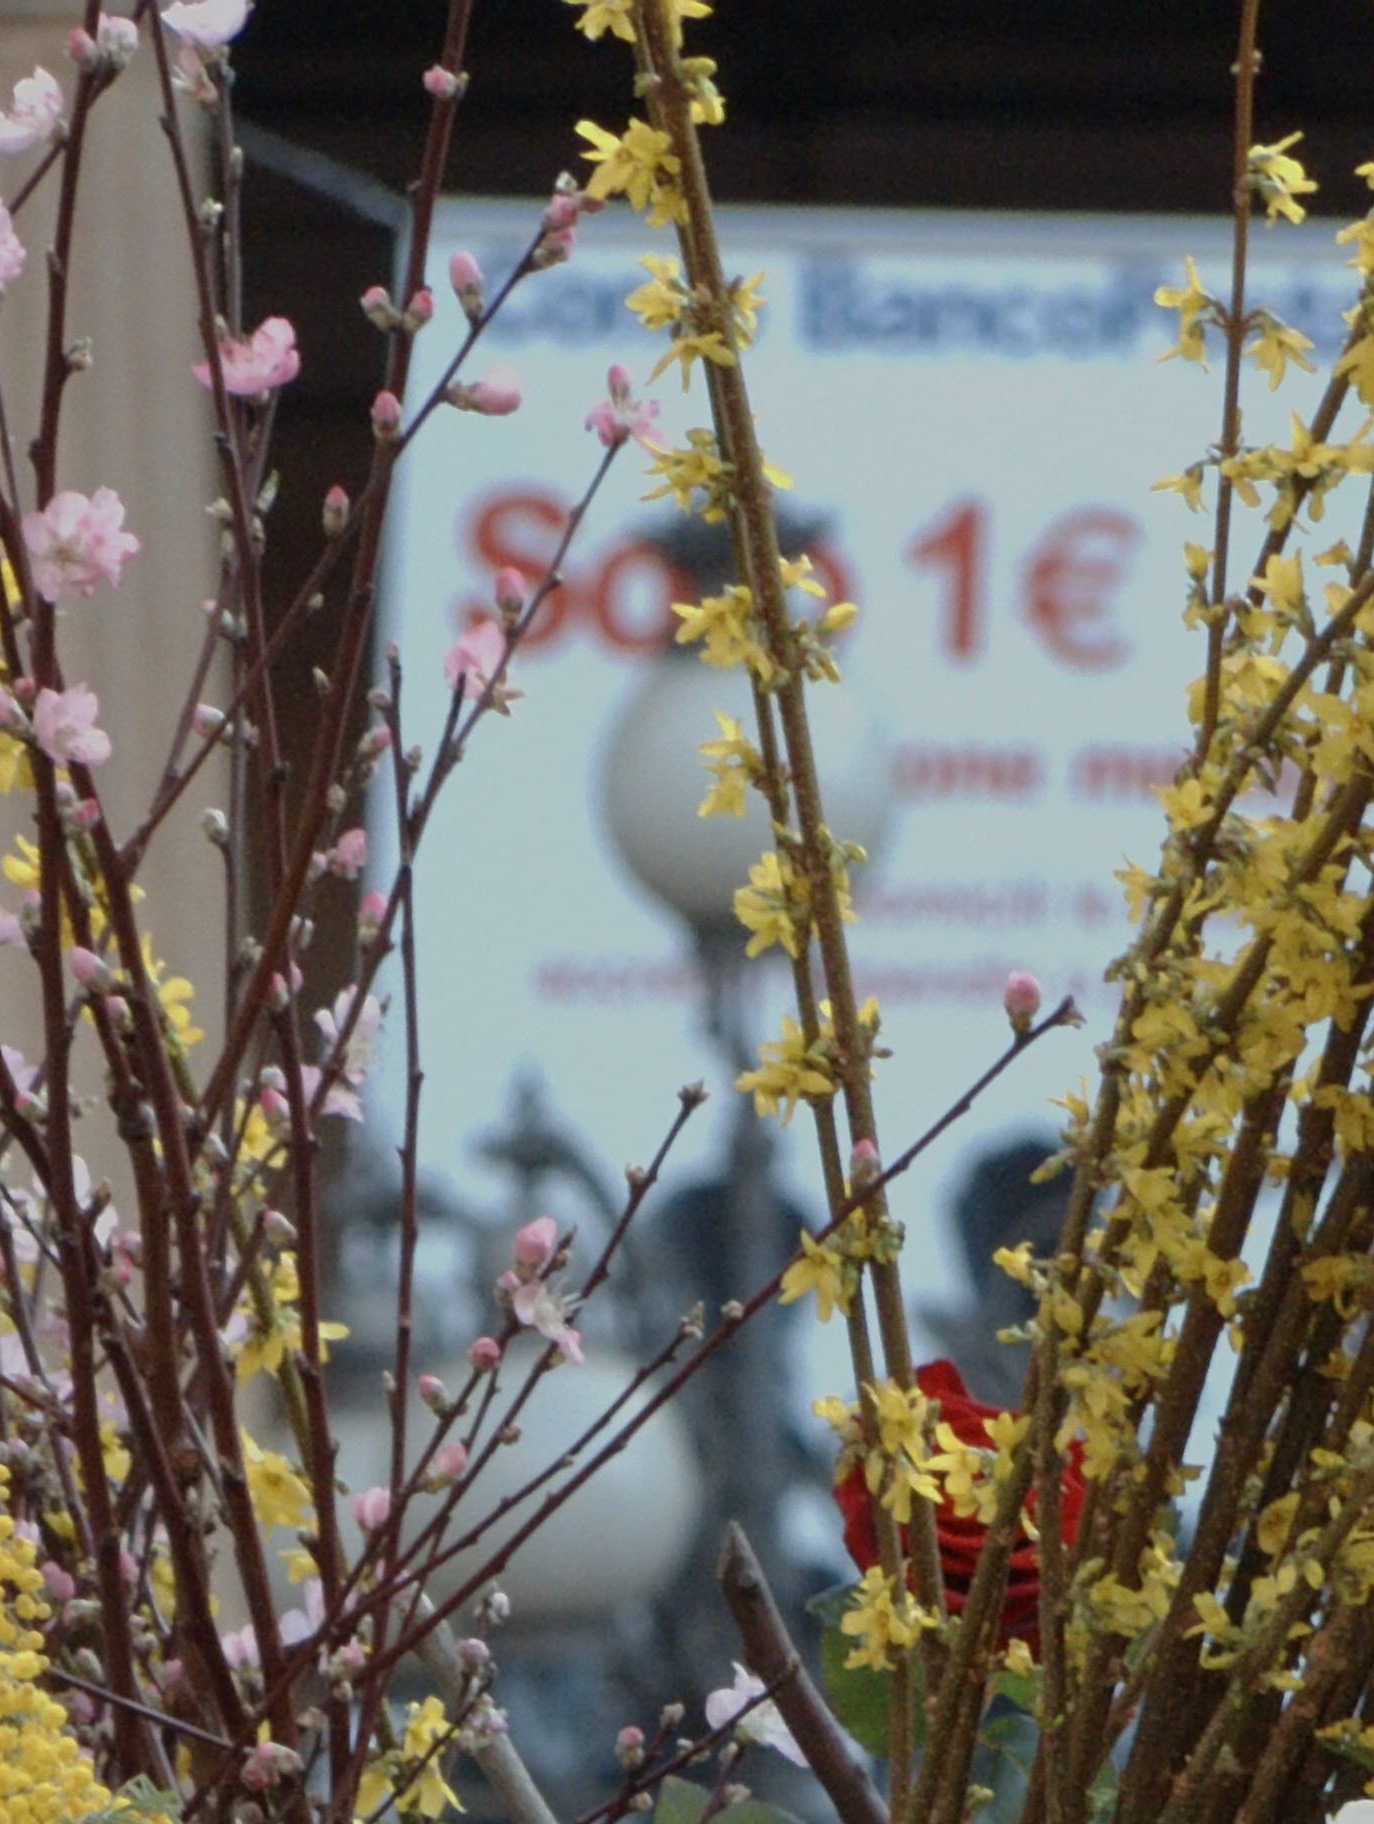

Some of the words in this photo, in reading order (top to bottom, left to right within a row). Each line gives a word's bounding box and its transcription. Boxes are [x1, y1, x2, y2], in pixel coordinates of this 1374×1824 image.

[799, 250, 1367, 352] BancoP
[459, 482, 853, 664] Soo
[909, 496, 1142, 672] 1€
